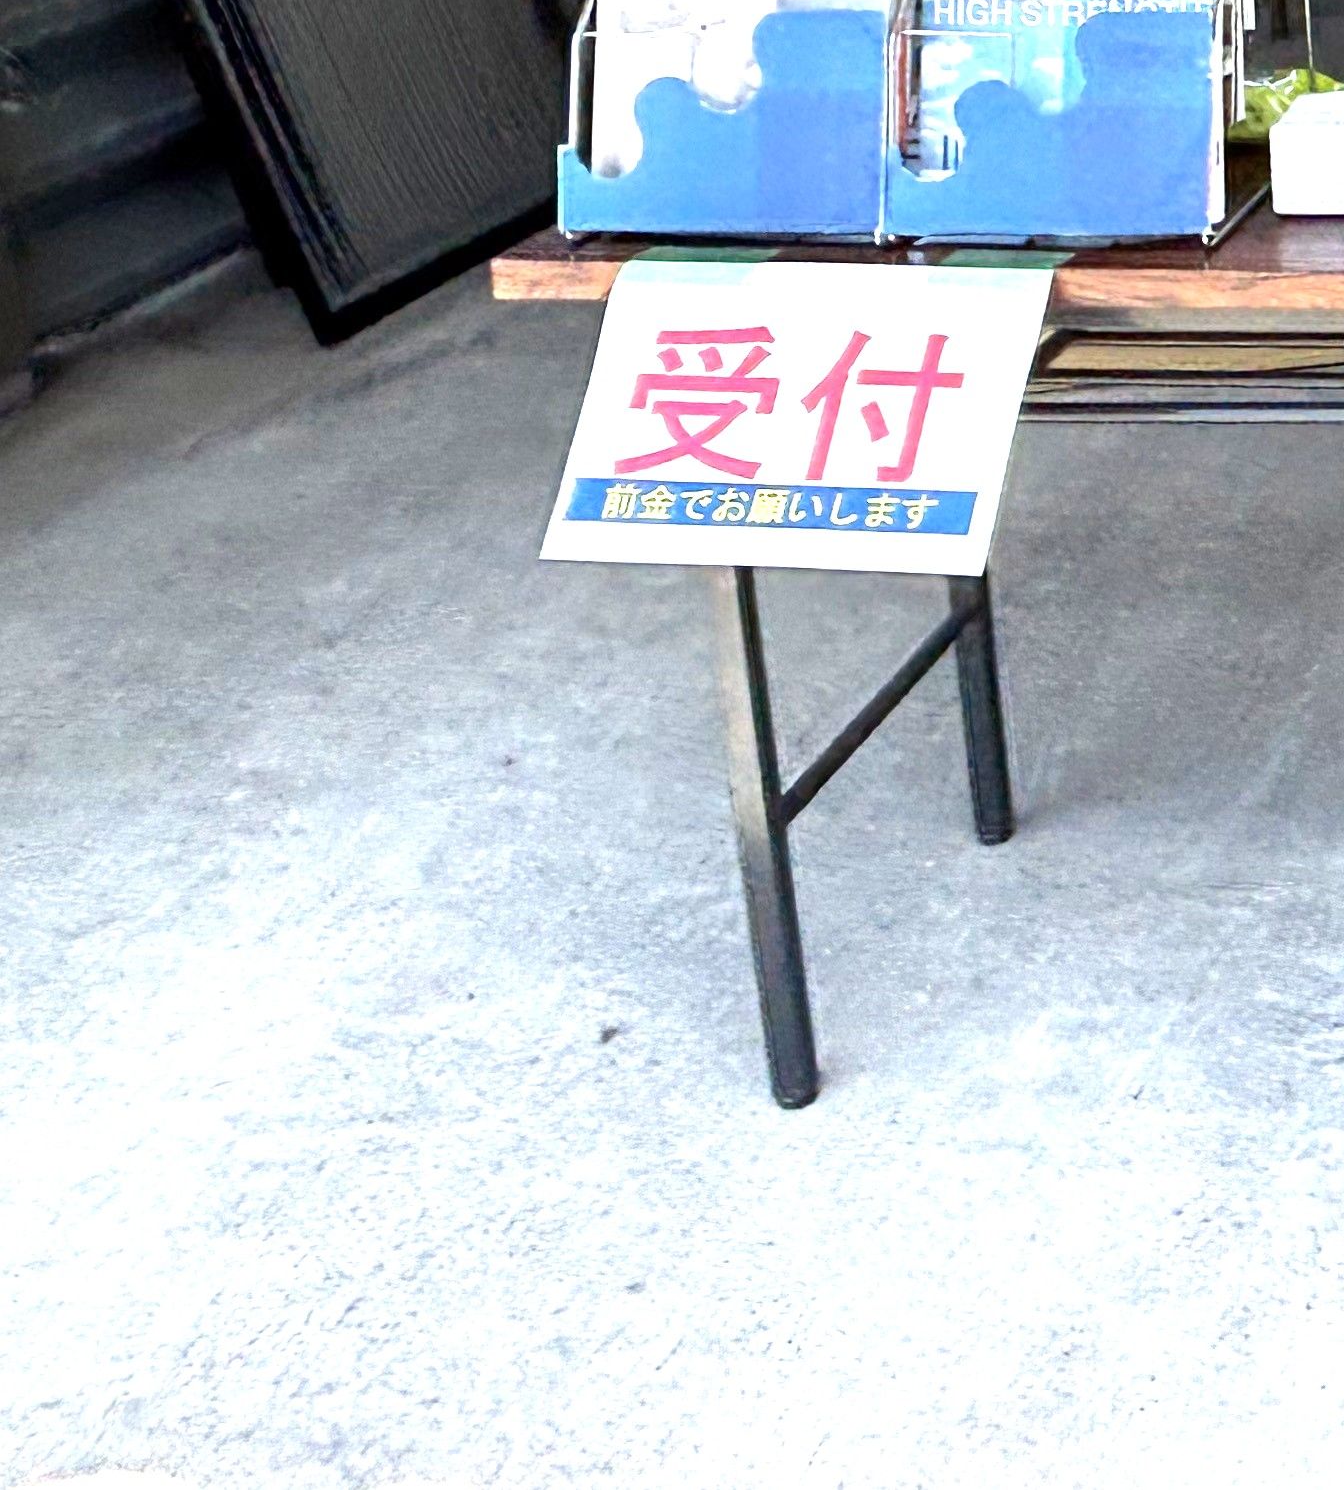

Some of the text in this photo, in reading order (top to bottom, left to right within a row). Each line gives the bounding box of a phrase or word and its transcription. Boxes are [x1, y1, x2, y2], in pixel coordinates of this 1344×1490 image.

[614, 326, 965, 483] 受付
[601, 482, 940, 532] 前金でお願いします
